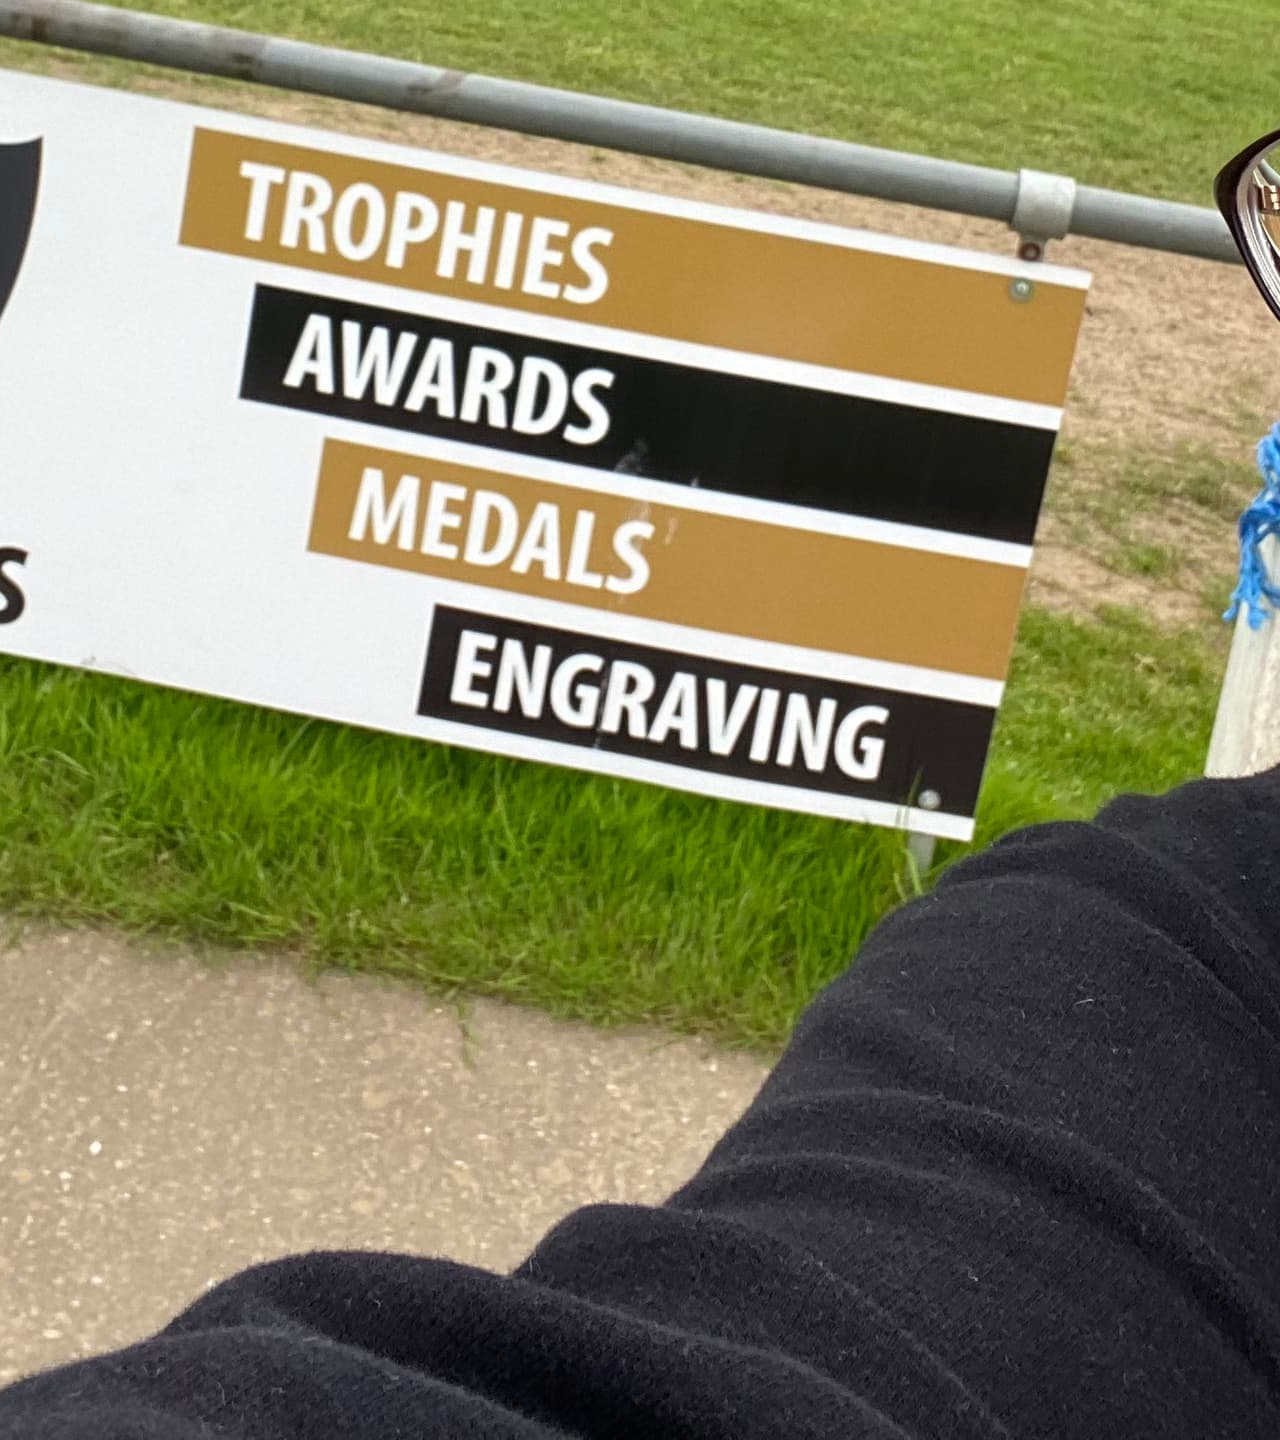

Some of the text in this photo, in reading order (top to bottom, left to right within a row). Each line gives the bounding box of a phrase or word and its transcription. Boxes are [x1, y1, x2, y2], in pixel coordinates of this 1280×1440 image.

[240, 161, 614, 304] TROPHIES
[283, 313, 615, 445] AWARDS
[348, 467, 655, 595] MEDALS
[450, 629, 889, 780] ENGRAVING
